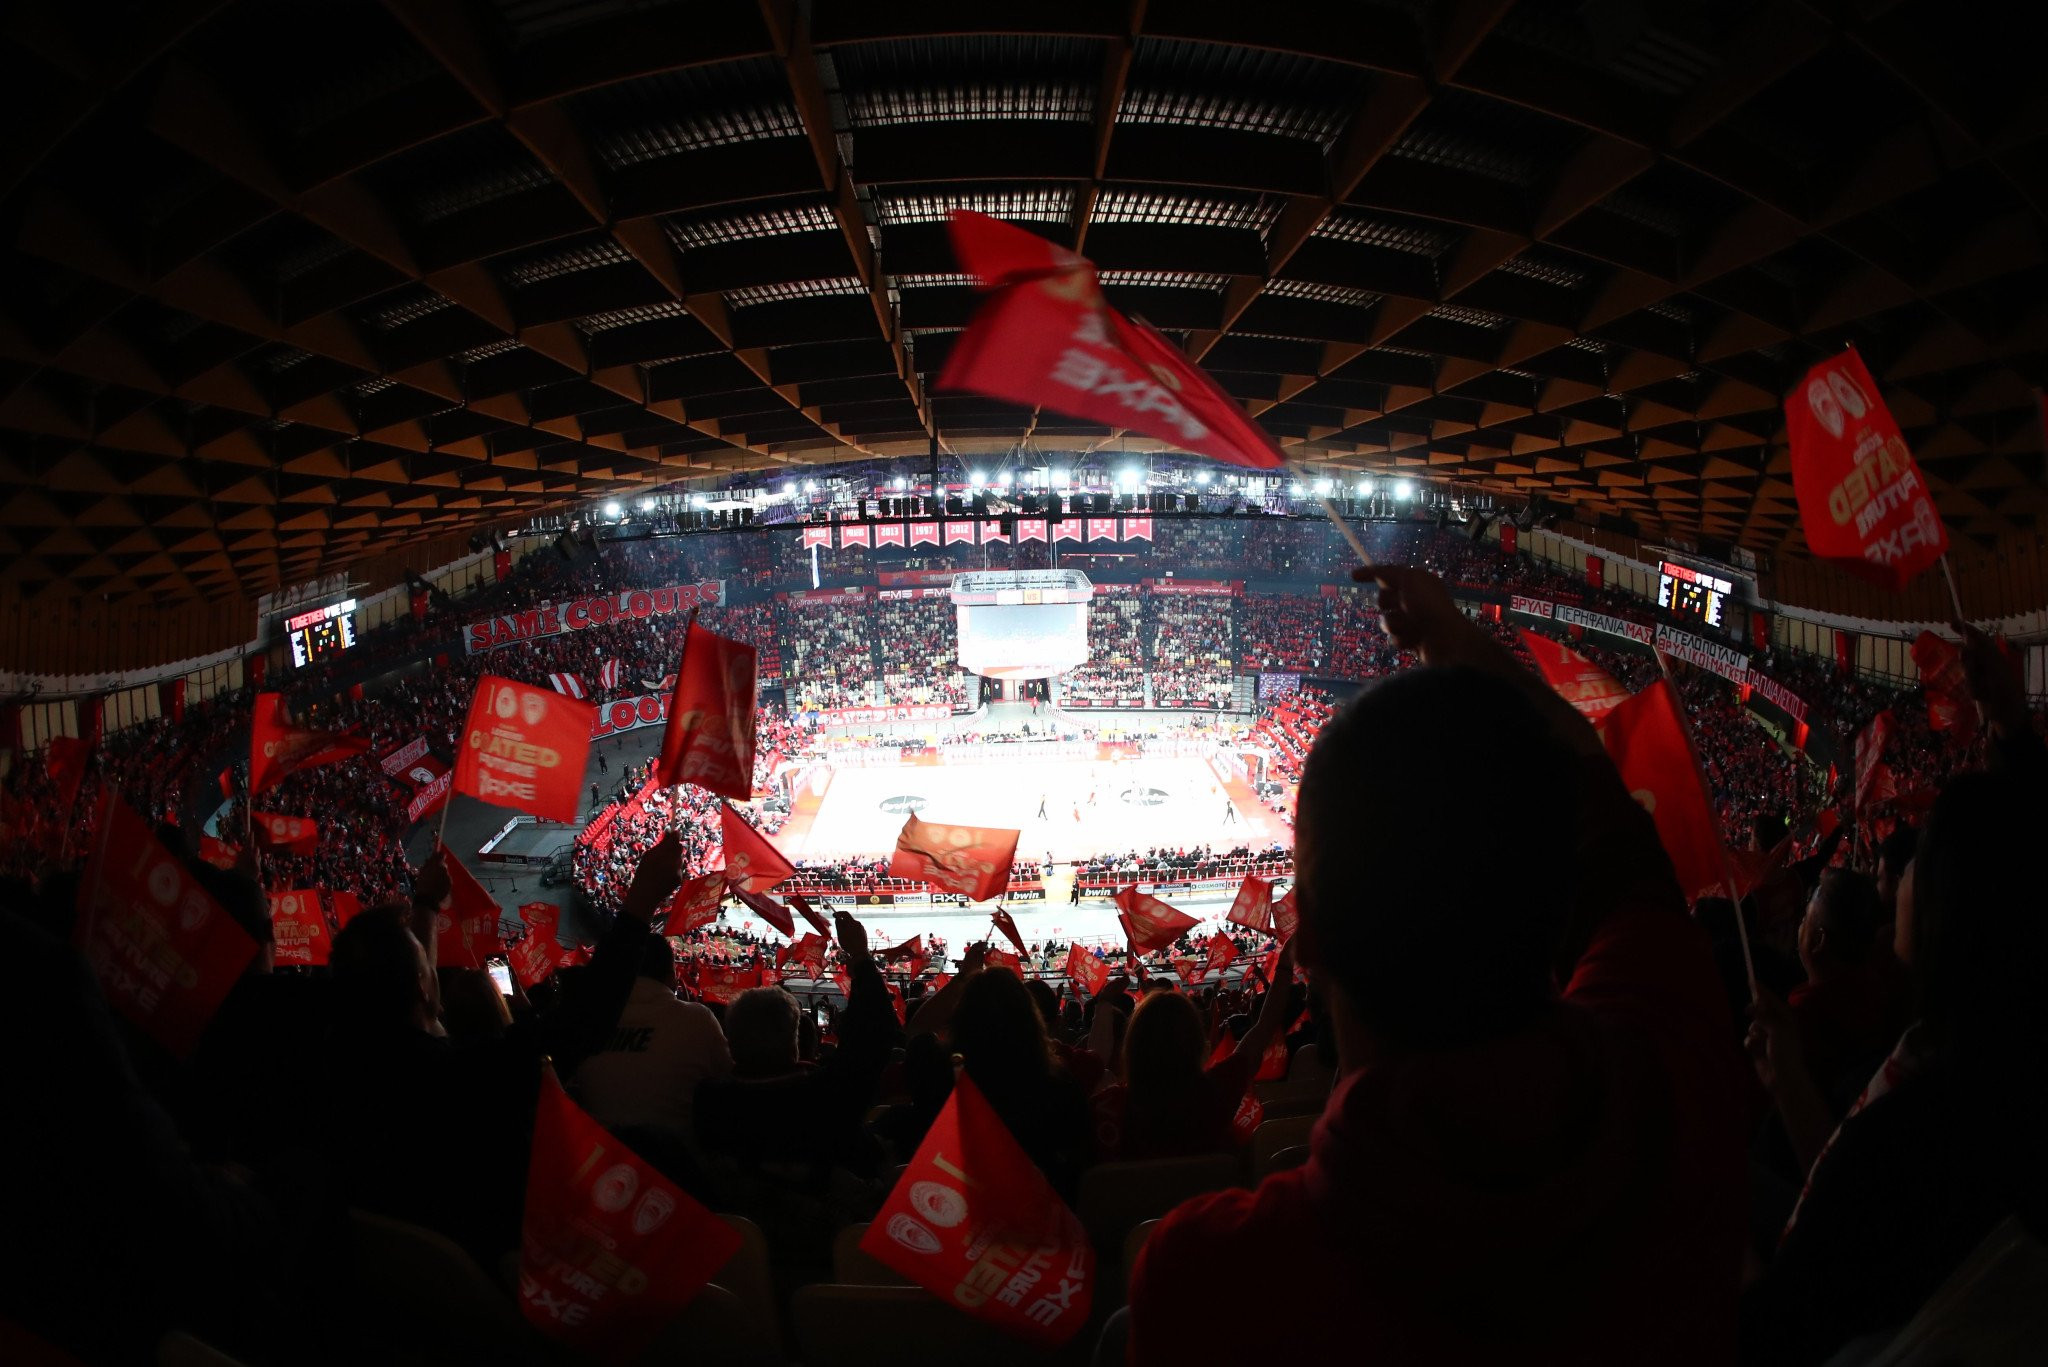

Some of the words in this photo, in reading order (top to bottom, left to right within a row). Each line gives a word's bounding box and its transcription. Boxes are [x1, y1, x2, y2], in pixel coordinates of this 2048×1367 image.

[986, 524, 1001, 533] 201
[470, 608, 561, 650] SAME
[565, 581, 721, 631] COLOURS
[1512, 598, 1552, 616] ΘΡΥΛΕ
[590, 693, 673, 739] LOO
[932, 894, 968, 904] AXE
